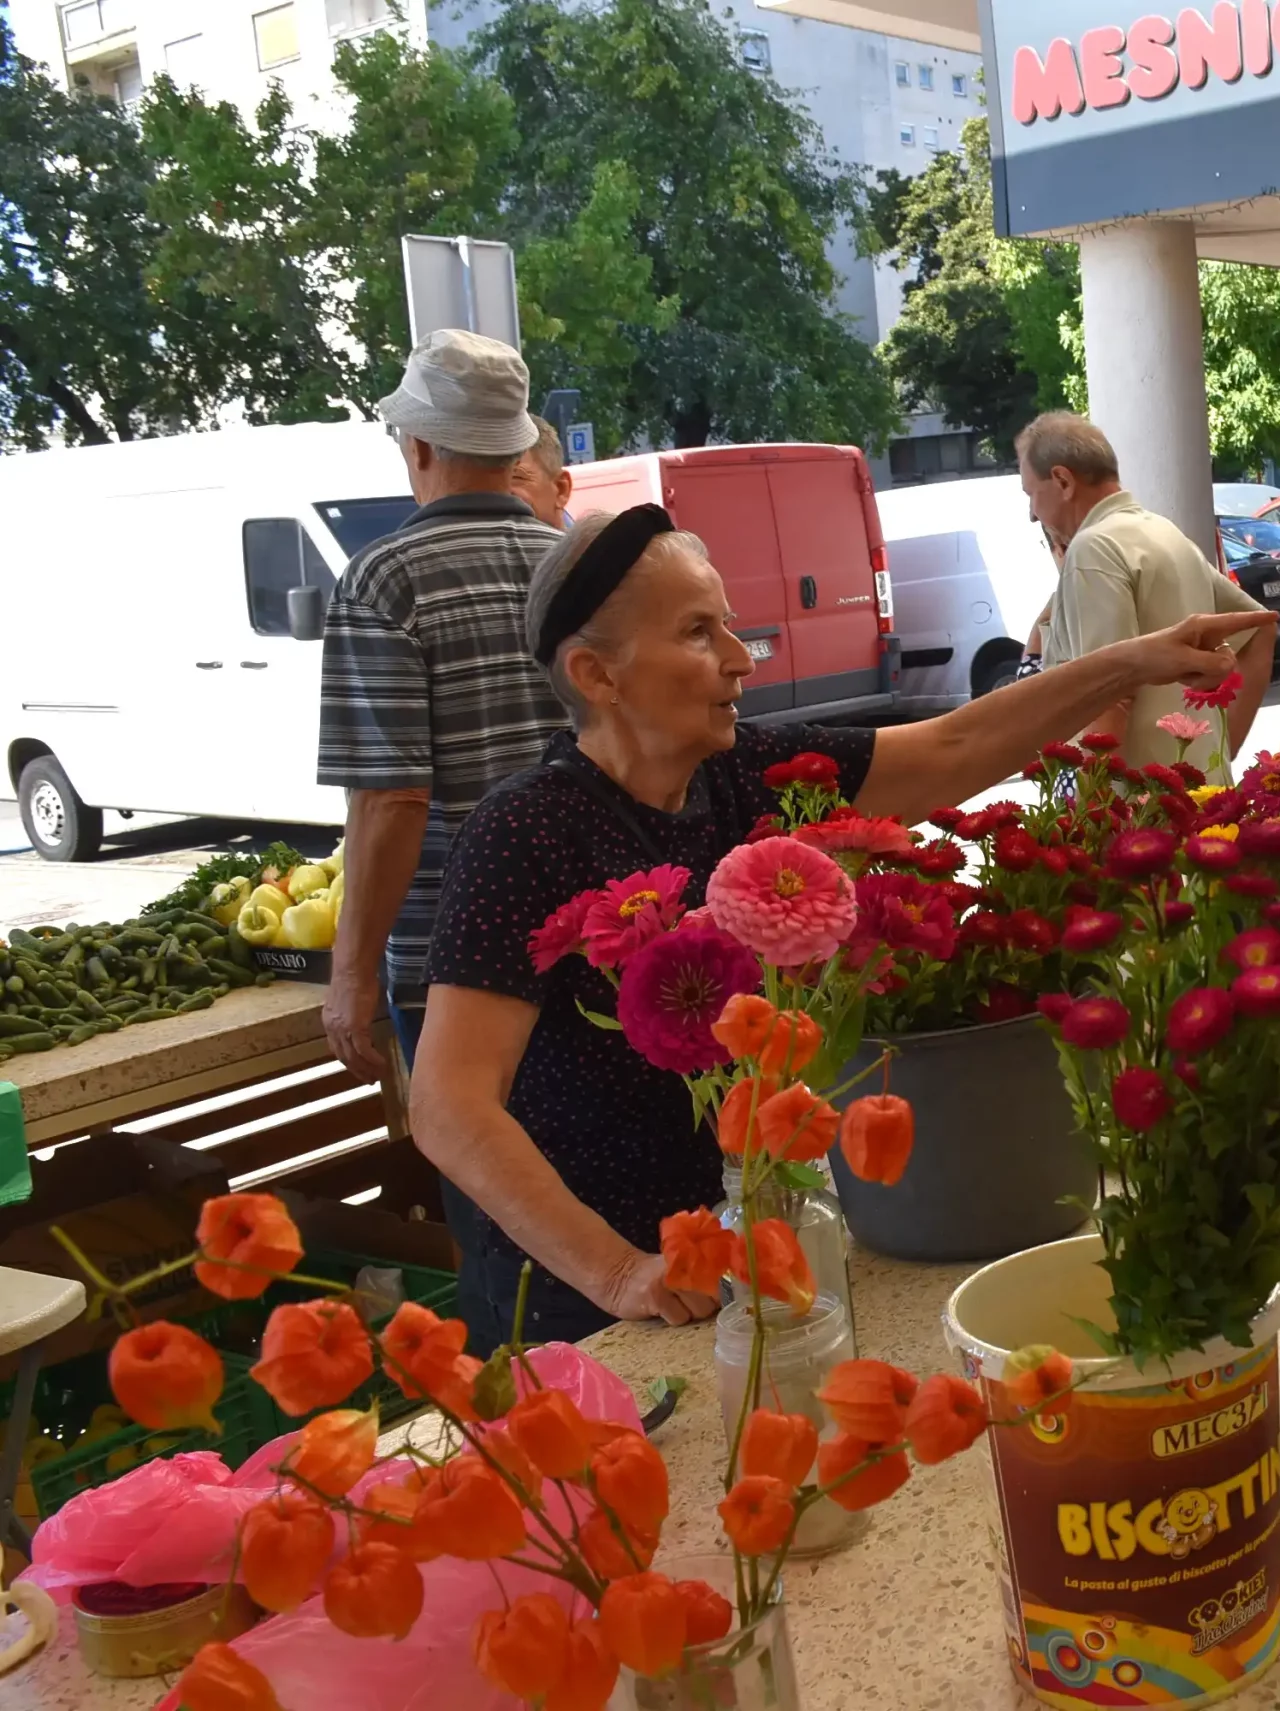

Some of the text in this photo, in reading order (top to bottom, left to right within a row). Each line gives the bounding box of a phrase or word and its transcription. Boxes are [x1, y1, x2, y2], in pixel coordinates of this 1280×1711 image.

[1163, 1401, 1247, 1454] MEC3
[1064, 1576, 1078, 1588] La
[1080, 1579, 1115, 1591] pasta
[1117, 1578, 1129, 1590] al
[1131, 1576, 1167, 1592] gusto
[1168, 1570, 1181, 1583] di
[1183, 1558, 1227, 1581] biscotto
